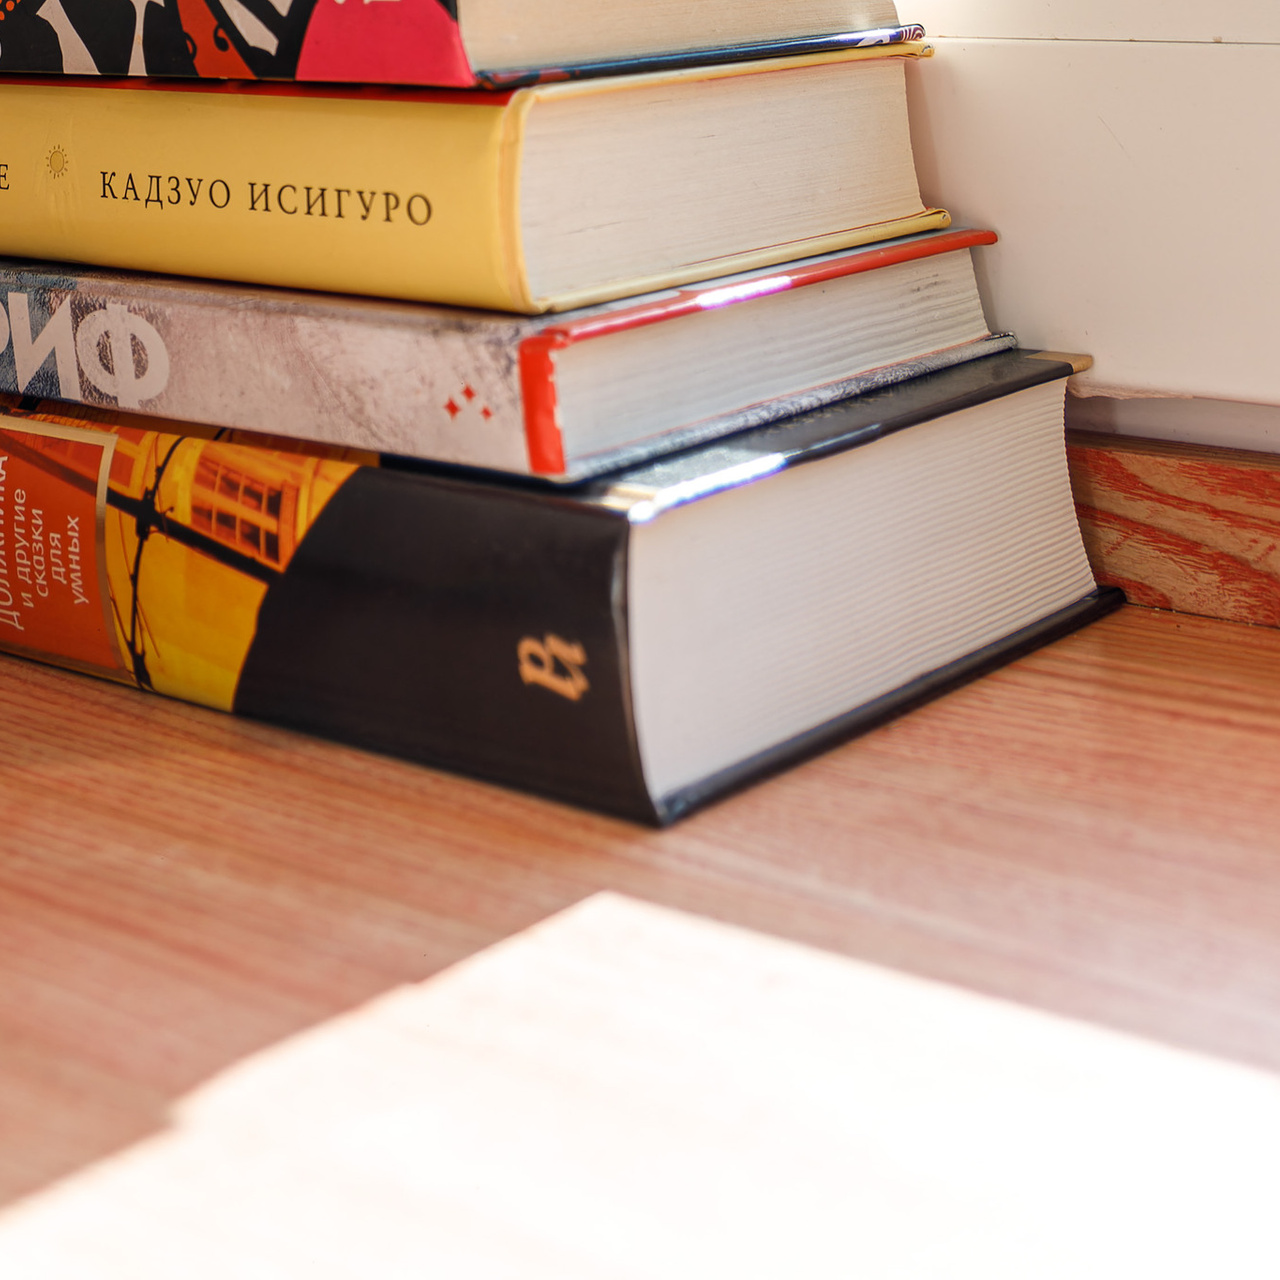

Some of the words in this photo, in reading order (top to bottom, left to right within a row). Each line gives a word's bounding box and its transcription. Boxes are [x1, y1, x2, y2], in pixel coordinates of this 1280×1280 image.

[99, 170, 232, 209] КАДЗУО
[247, 181, 435, 227] ИСИГУРО
[13, 489, 31, 583] другие
[31, 509, 48, 596] сказки
[49, 533, 66, 583] для
[70, 513, 90, 607] умных
[19, 592, 34, 606] и
